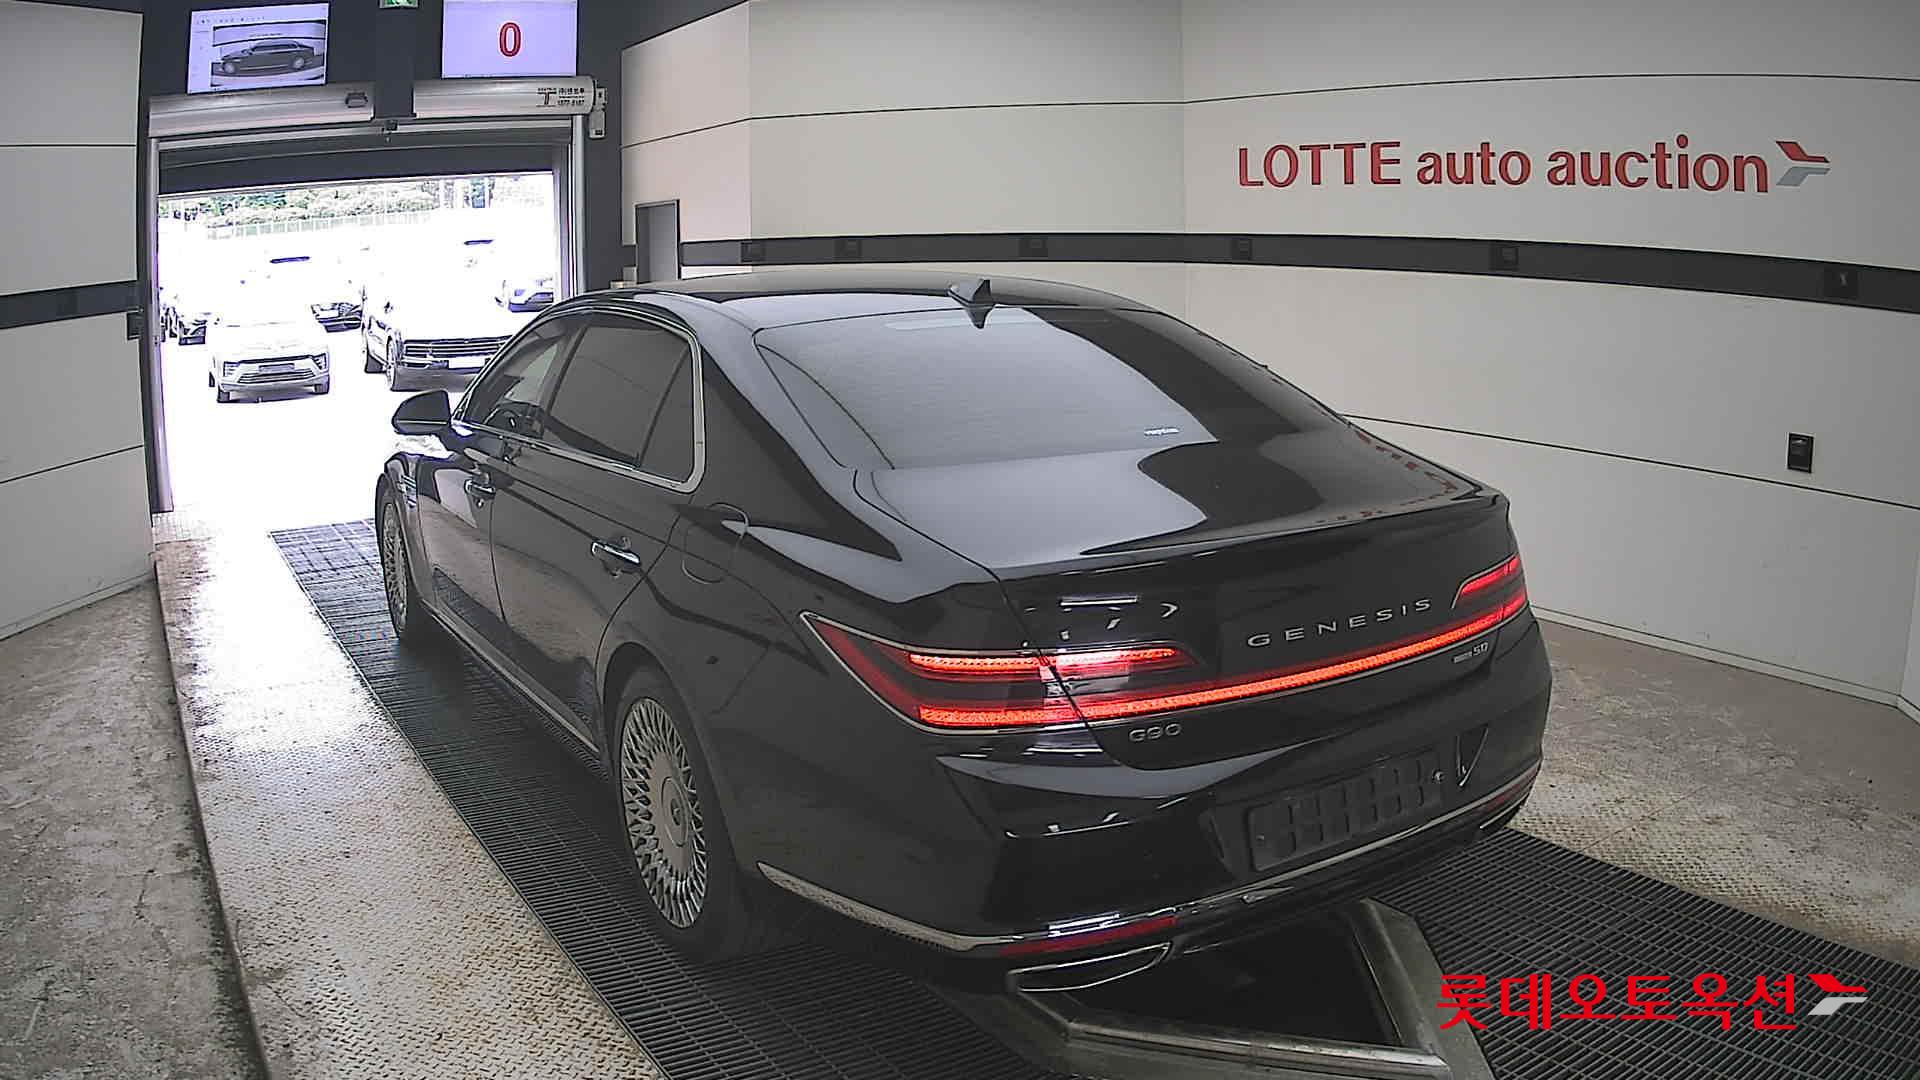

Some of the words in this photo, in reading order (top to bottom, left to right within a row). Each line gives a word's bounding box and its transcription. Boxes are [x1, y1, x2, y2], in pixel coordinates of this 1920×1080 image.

[499, 22, 522, 57] 0
[1238, 141, 1400, 187] LOTTE
[1416, 141, 1531, 185] auto
[1546, 134, 1769, 193] auction
[1247, 599, 1432, 647] GENESIS
[1128, 723, 1182, 742] G90
